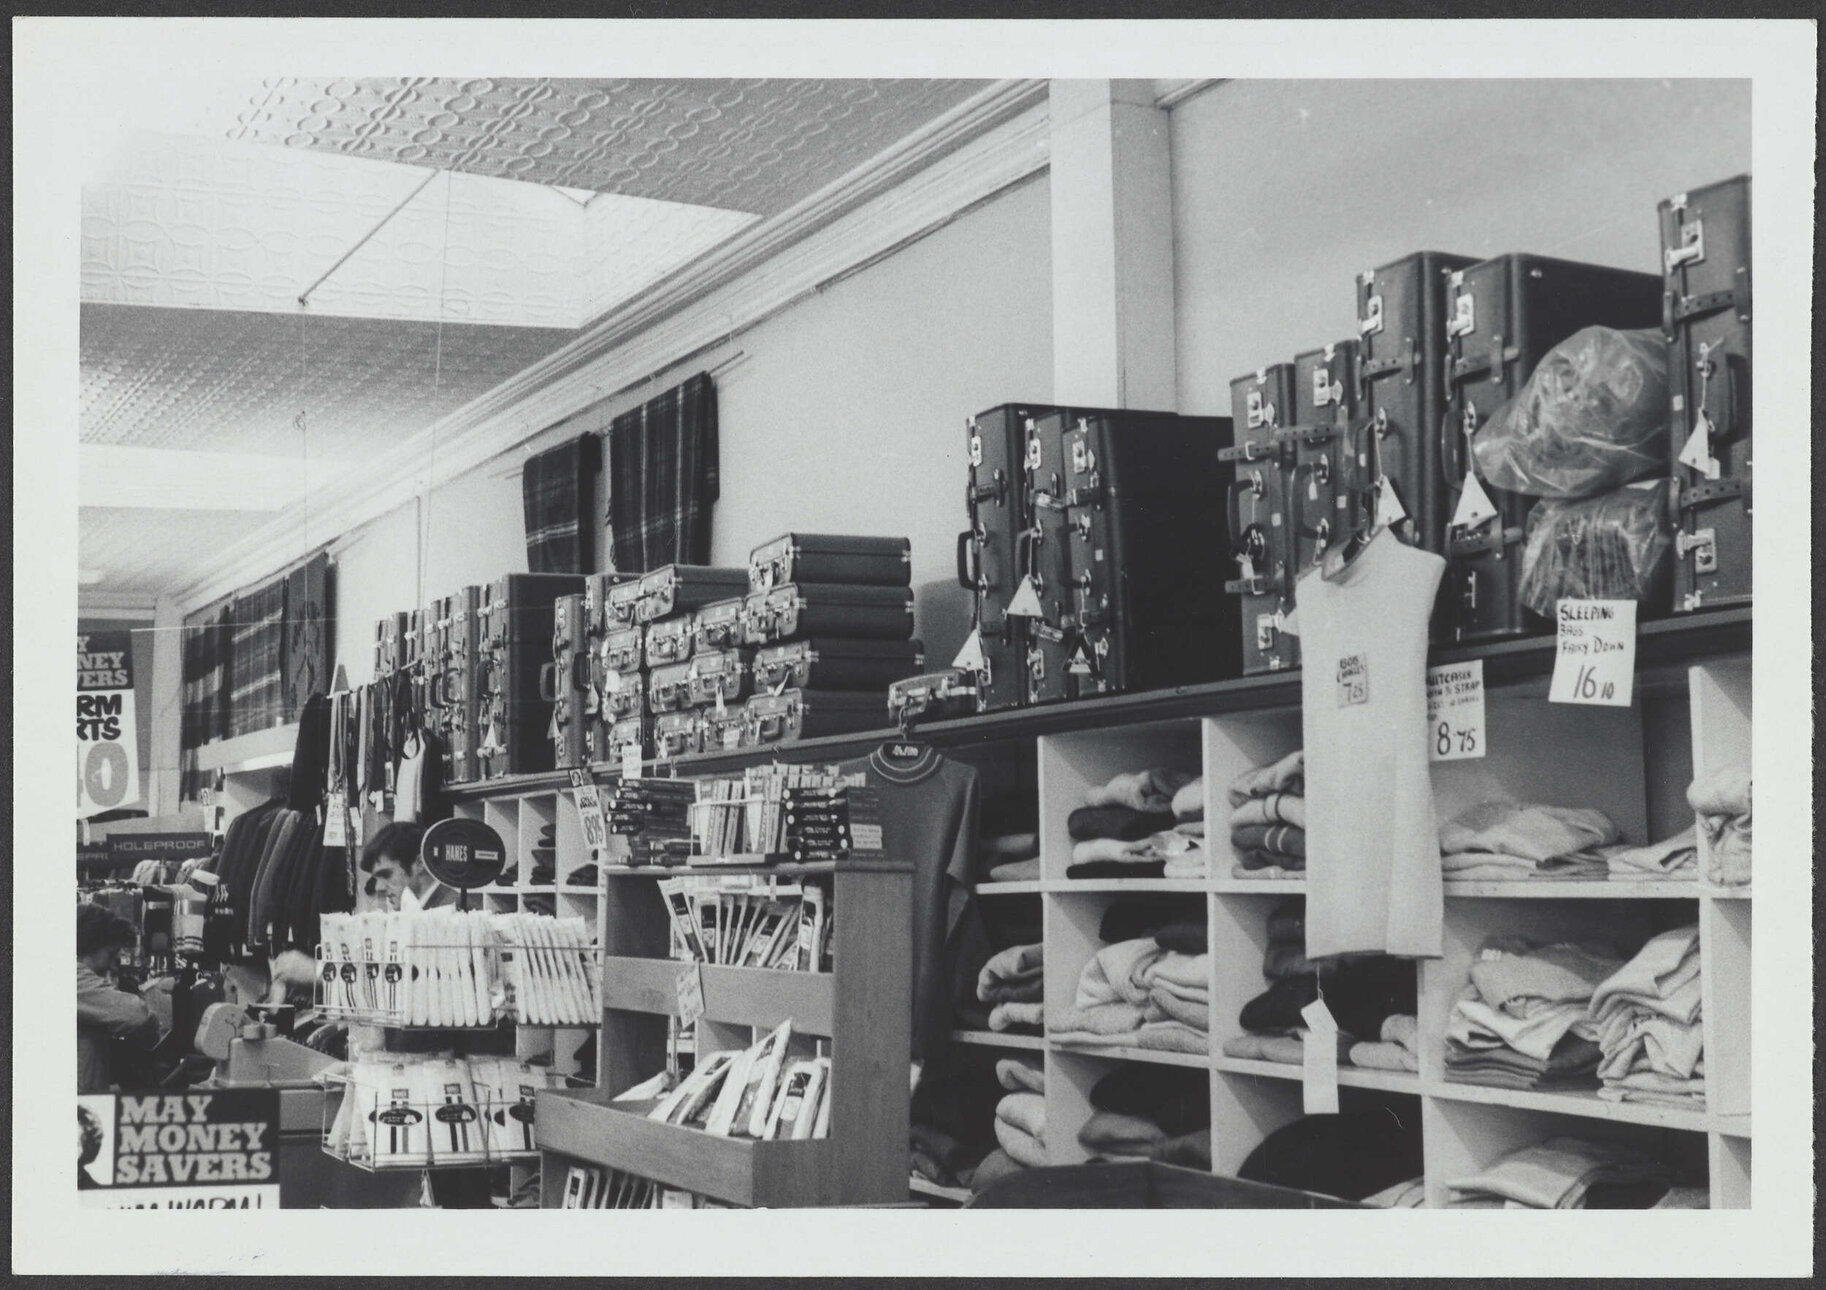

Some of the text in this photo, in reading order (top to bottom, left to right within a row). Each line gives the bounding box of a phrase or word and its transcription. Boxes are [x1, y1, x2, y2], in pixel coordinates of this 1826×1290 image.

[1560, 604, 1614, 621] SLEEPING
[77, 669, 128, 687] ERS
[113, 840, 205, 851] HOLEPROOF
[445, 844, 468, 862] HANES
[120, 1095, 212, 1123] MAY
[119, 1123, 267, 1154] MONEY
[116, 1152, 272, 1184] SAVERS
